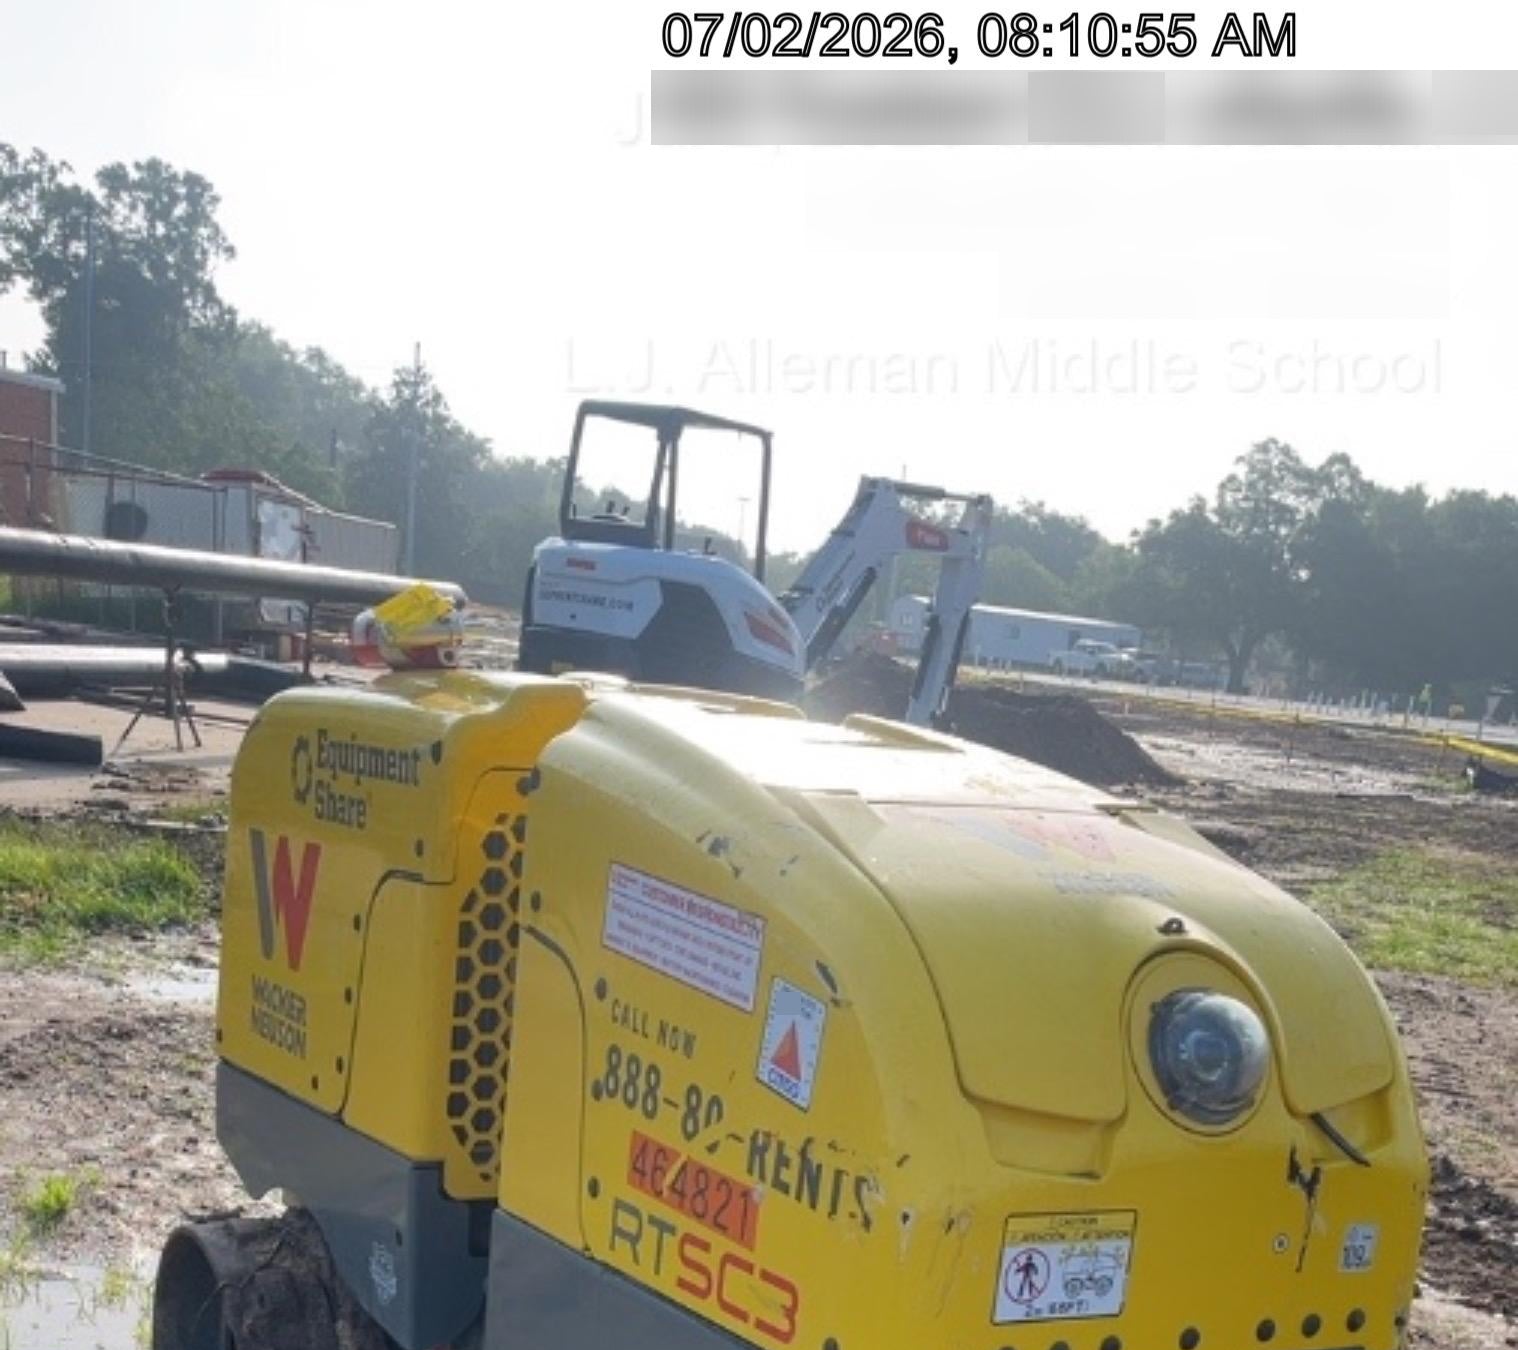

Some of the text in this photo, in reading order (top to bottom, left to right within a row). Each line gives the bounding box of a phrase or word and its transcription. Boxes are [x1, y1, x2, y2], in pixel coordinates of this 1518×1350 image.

[317, 728, 421, 787] Equipment
[315, 780, 367, 829] Share
[611, 998, 697, 1060] CALL NOW
